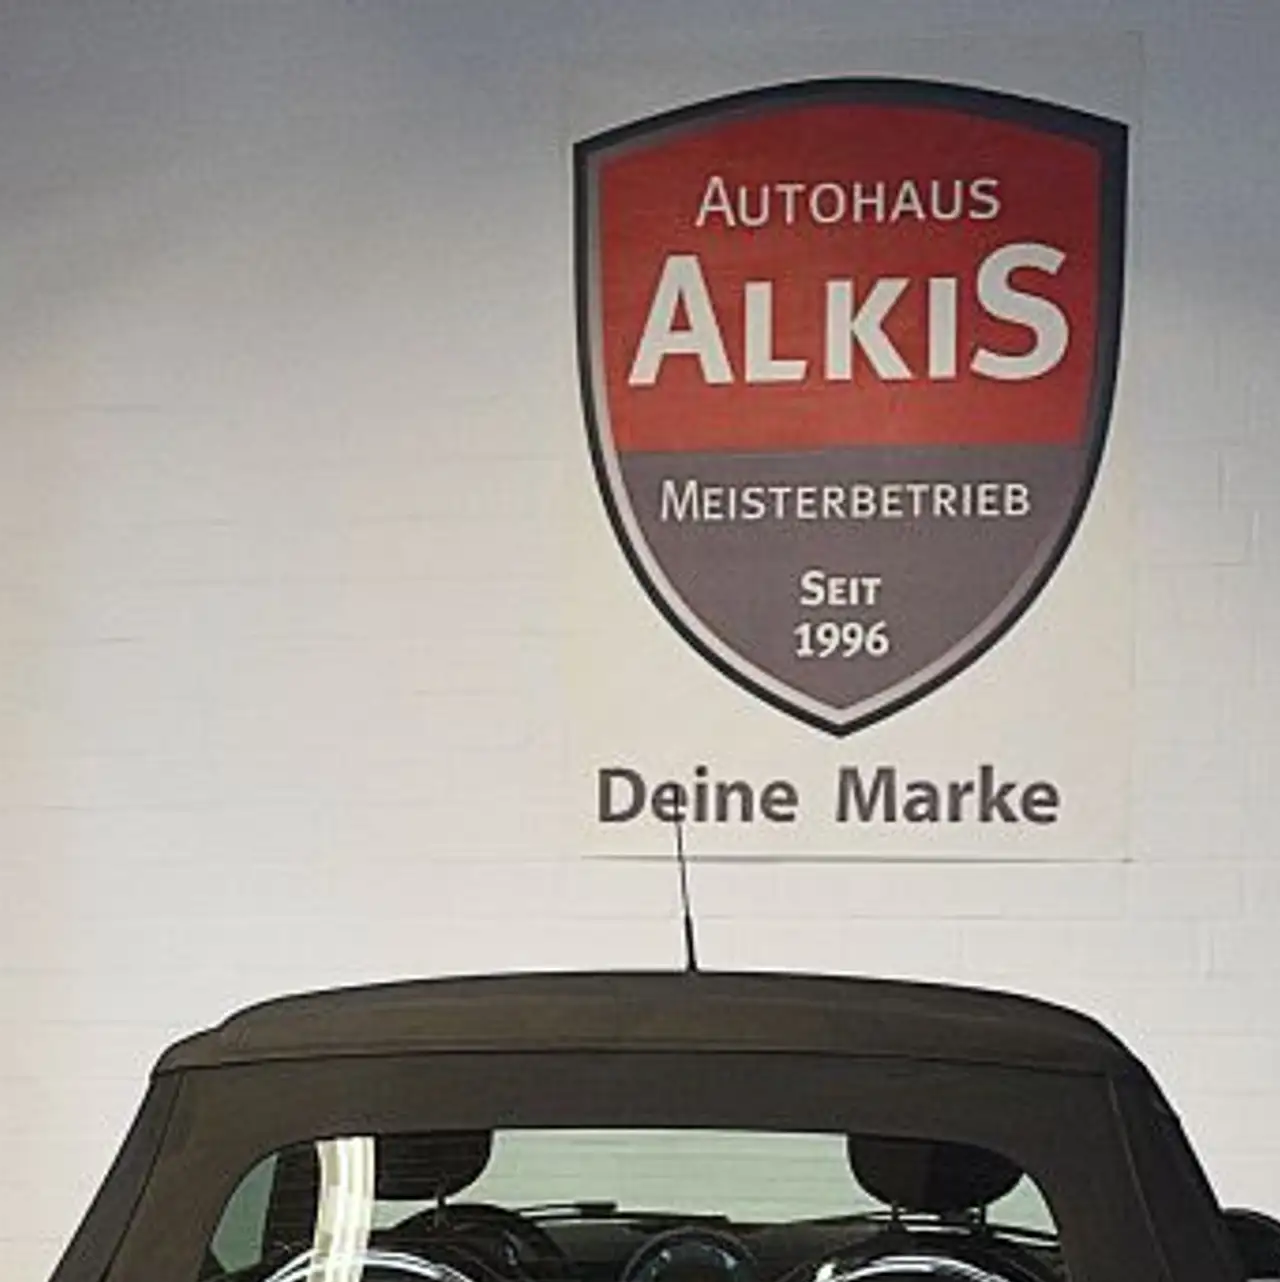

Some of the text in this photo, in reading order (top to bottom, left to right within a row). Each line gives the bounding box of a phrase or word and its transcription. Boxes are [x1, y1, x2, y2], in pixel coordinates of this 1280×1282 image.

[695, 176, 1001, 227] AUTOHAUS
[628, 242, 1070, 386] ALKIS
[661, 480, 1031, 523] MEISTERBETRIEB
[800, 570, 881, 606] SEIT
[795, 622, 889, 658] 1996
[597, 766, 1060, 824] Deine Marke
